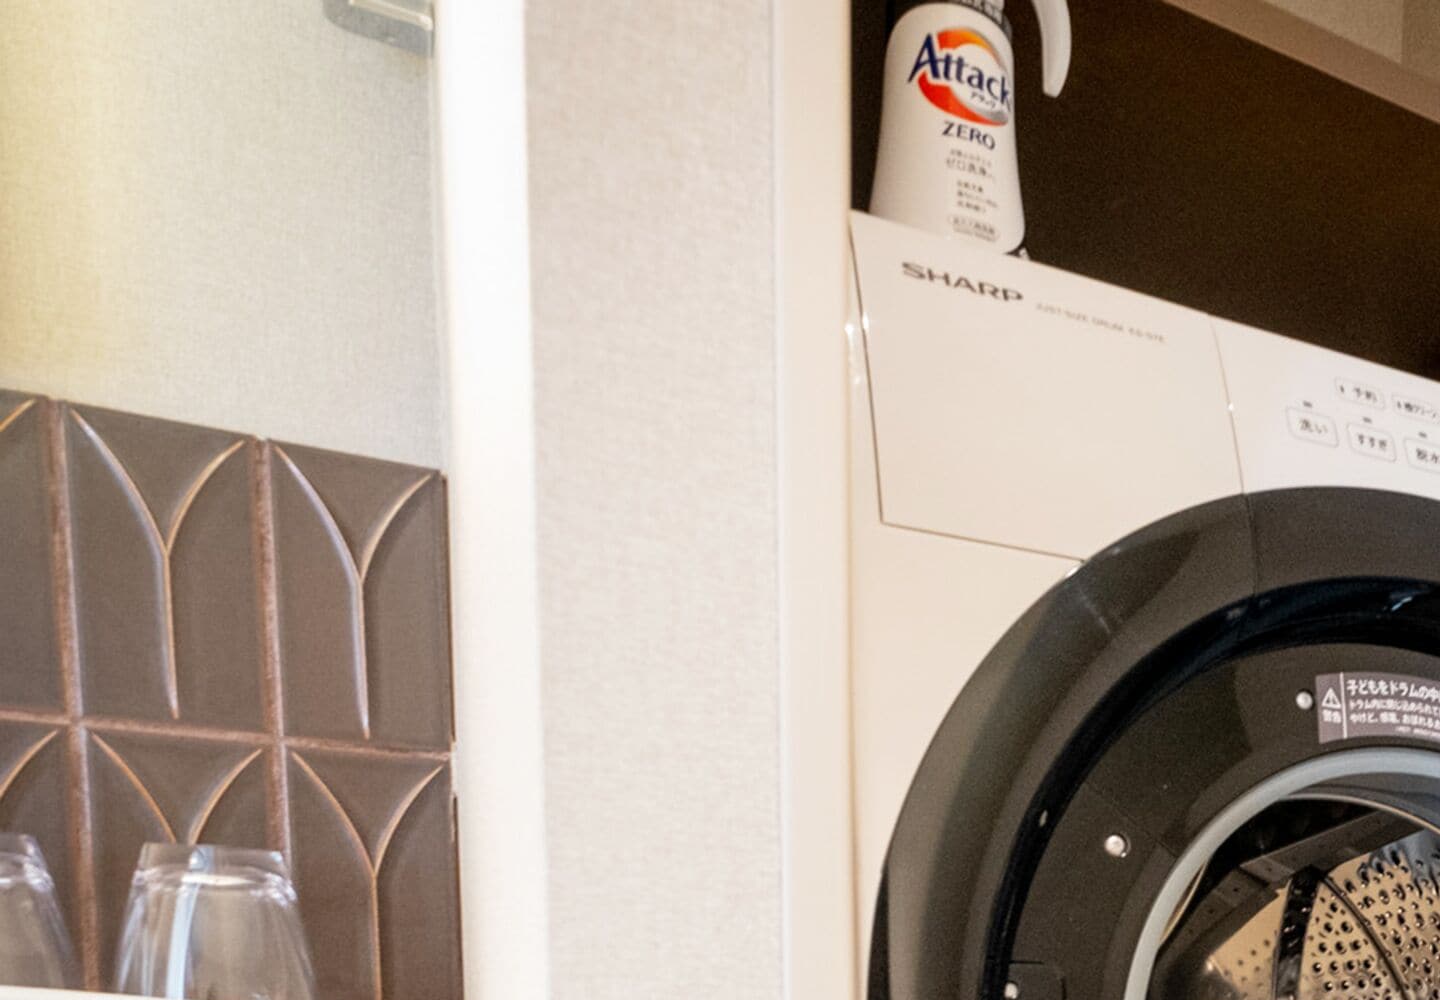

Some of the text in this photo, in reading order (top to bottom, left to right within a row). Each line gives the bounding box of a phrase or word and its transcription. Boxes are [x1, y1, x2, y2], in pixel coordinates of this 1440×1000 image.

[907, 33, 1011, 113] Attack
[942, 120, 996, 150] ZERO
[902, 262, 1024, 303] SHARP
